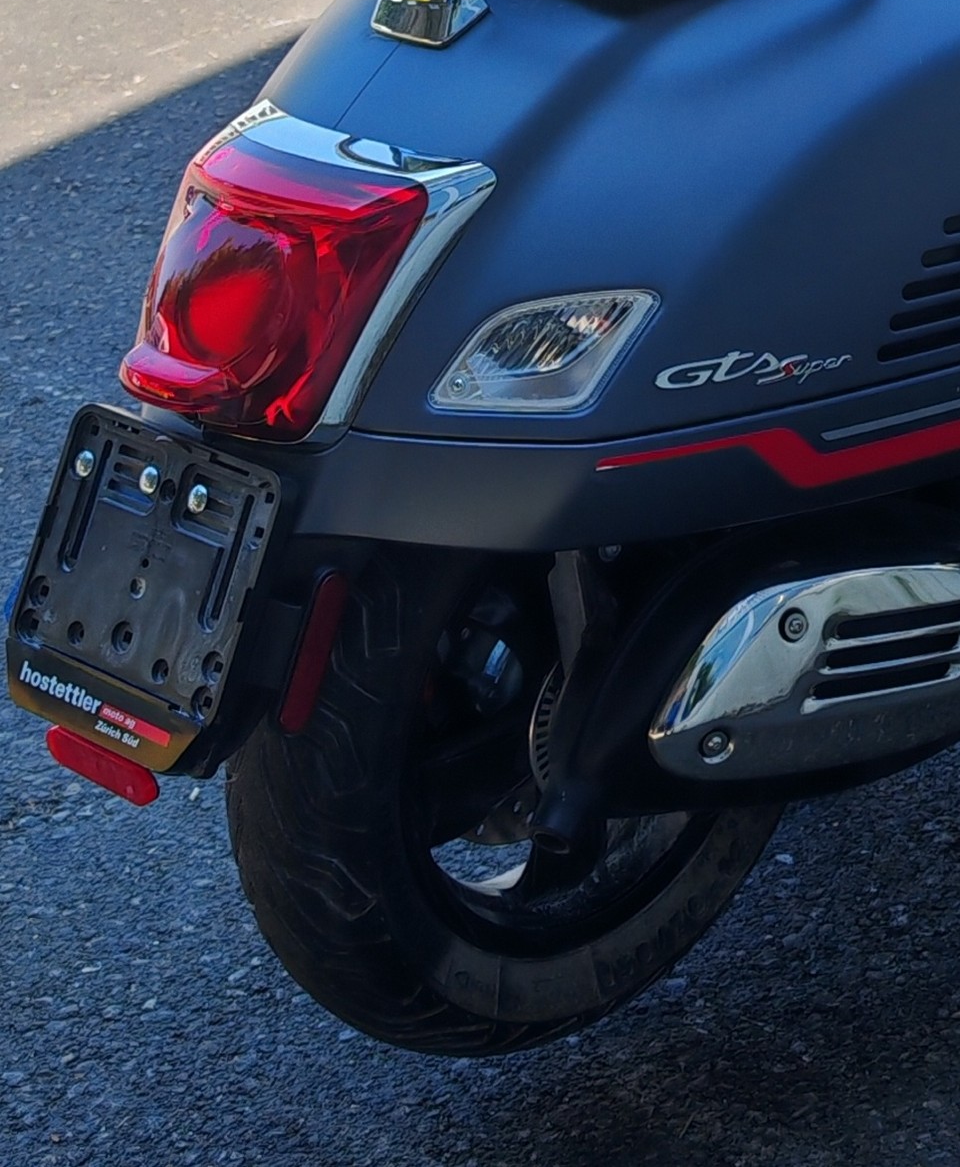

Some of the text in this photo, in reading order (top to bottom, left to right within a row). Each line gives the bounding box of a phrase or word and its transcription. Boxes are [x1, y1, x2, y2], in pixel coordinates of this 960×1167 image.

[20, 661, 102, 715] hostettler
[103, 707, 125, 722] moto
[94, 719, 140, 748] Zürich Süd
